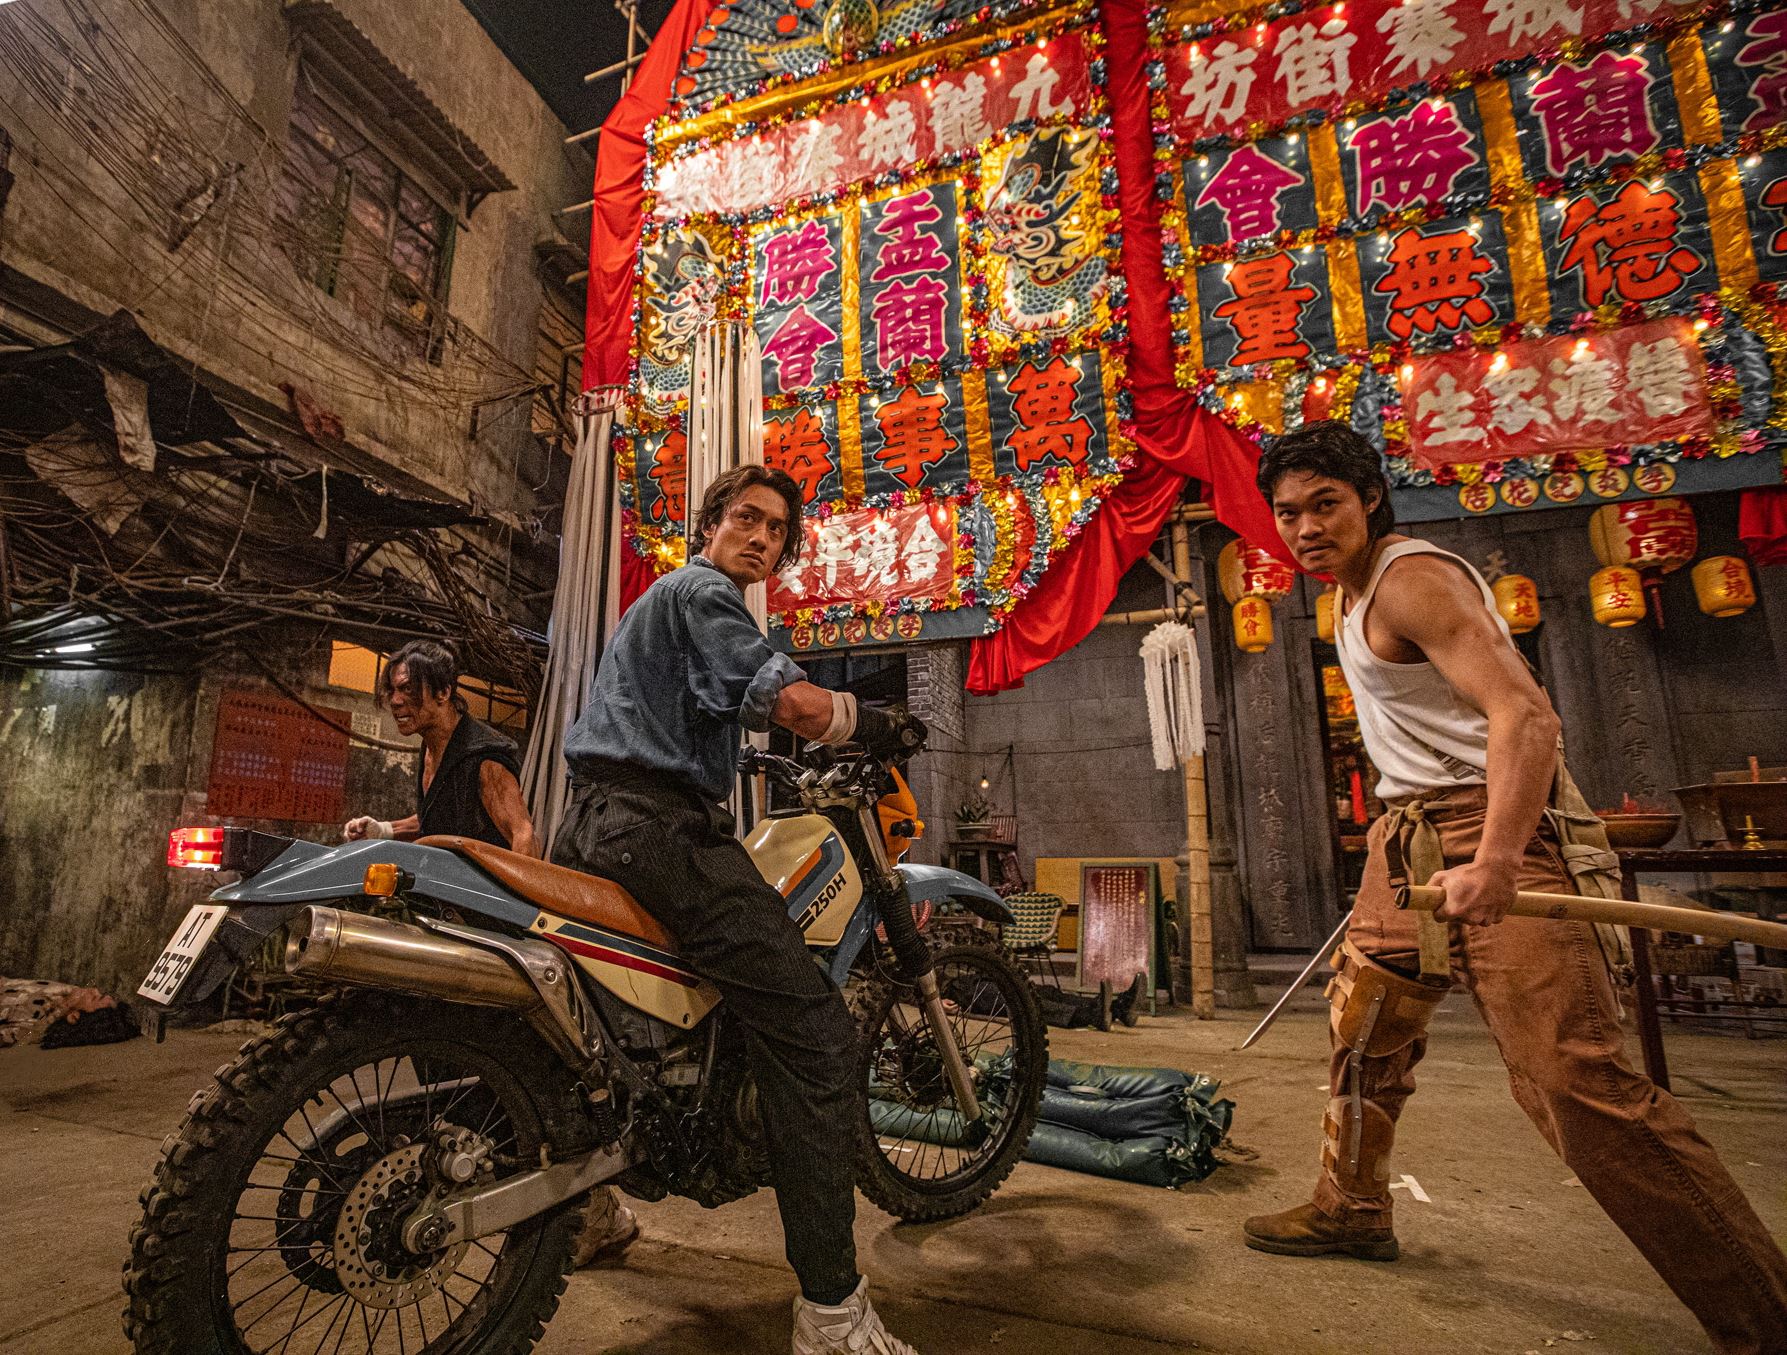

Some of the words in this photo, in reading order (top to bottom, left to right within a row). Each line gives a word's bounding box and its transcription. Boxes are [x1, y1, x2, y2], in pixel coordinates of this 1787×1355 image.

[1181, 0, 1693, 127] 城寨街坊
[1214, 175, 1787, 367] 德無量
[809, 871, 847, 918] 250H
[177, 911, 214, 949] AT
[144, 951, 193, 995] 9579
